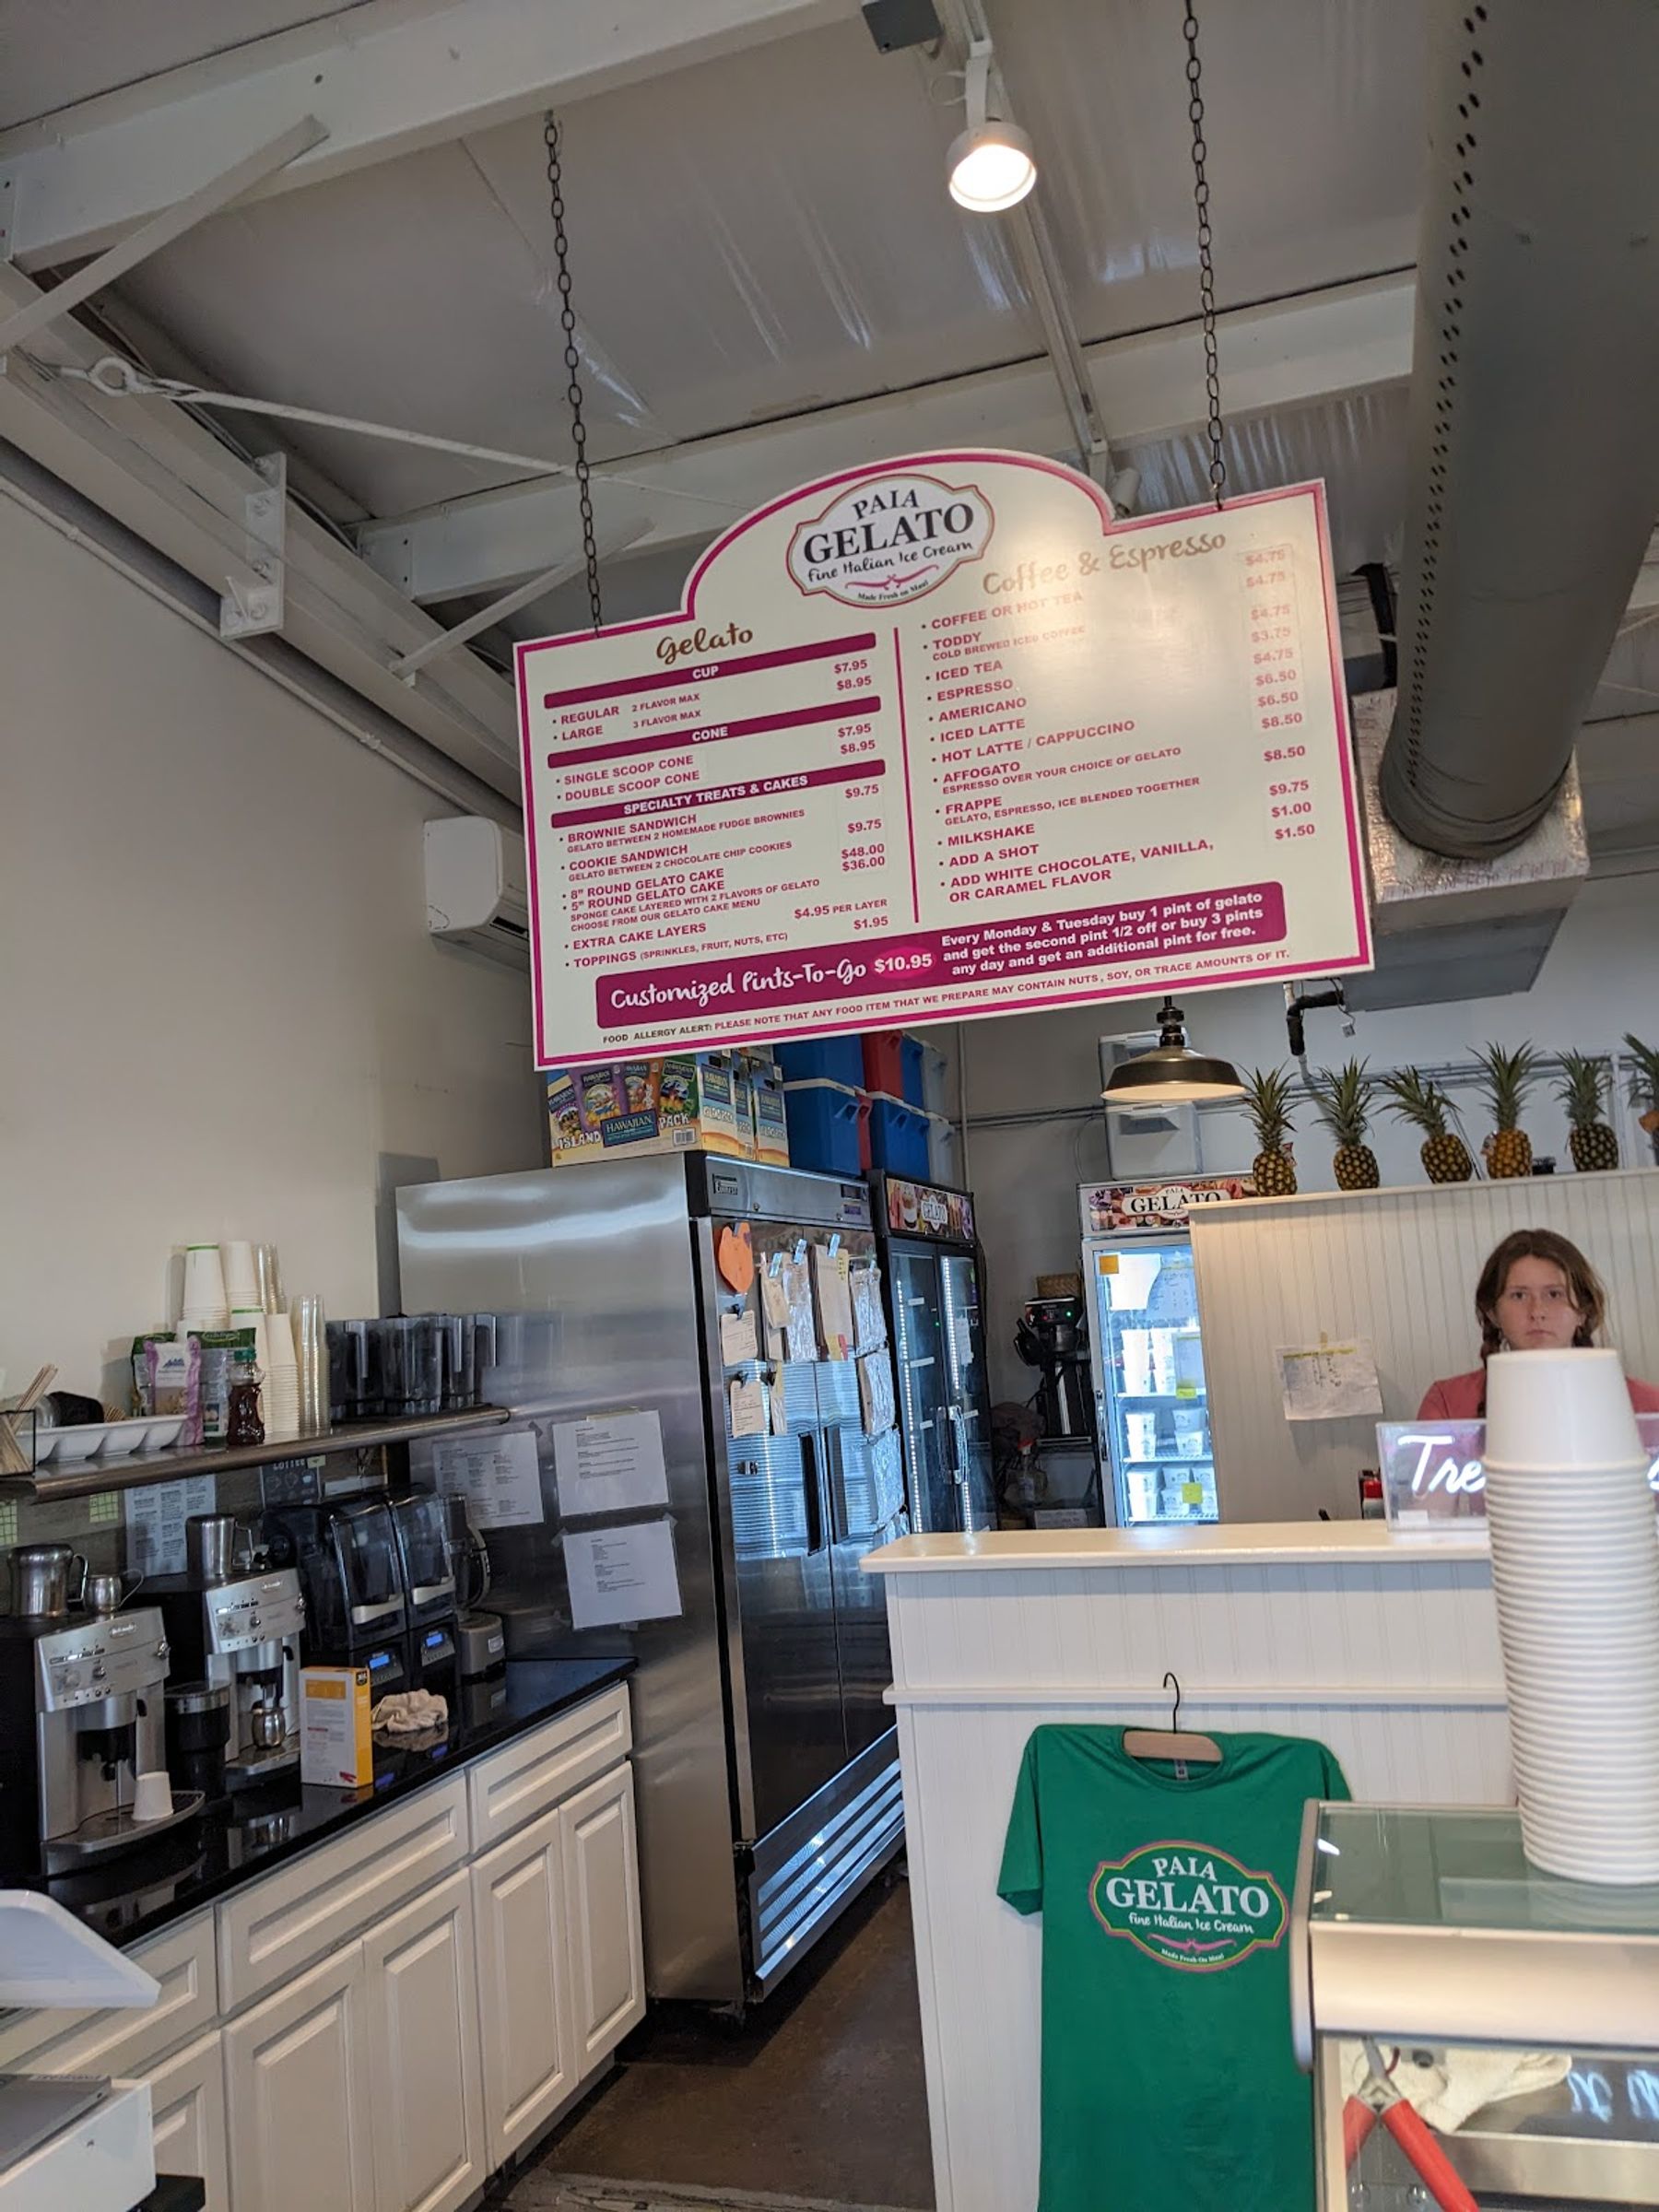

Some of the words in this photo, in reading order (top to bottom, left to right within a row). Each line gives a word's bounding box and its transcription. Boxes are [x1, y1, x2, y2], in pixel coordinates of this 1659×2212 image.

[852, 488, 921, 522] PAIA
[804, 503, 974, 565] GELATO
[842, 557, 895, 574] Italian
[900, 551, 919, 564] Ice
[923, 540, 973, 559] Cream
[982, 561, 1070, 595] Coffee
[1078, 552, 1100, 576] &
[1110, 533, 1227, 573] Espresso
[656, 622, 754, 665] Gelato
[931, 611, 986, 629] COFFEE
[933, 633, 981, 649] TODDY
[692, 666, 719, 678] CUP
[933, 649, 961, 661] COLD
[964, 641, 1010, 655] BREWED
[935, 666, 970, 681] ICED
[973, 661, 1003, 674] TEA
[561, 706, 619, 724] REGULAR
[640, 698, 677, 710] FLAVOR
[678, 694, 700, 703] MAX
[834, 660, 867, 674] $7.95
[562, 726, 603, 741] LARGE
[641, 714, 677, 727] FLAVOR
[679, 711, 700, 720] MAX
[837, 677, 872, 690] $8.95
[937, 680, 1013, 701] ESPRESSO
[939, 699, 1026, 722] AMERICANO
[940, 728, 974, 742] ICED
[979, 719, 1025, 735] LATTE
[1255, 670, 1297, 686] $6.50
[692, 727, 728, 741] CONE
[942, 748, 971, 762] HOT
[977, 740, 1023, 757] LATTE
[1028, 739, 1031, 747] /
[1036, 722, 1135, 746] CAPPUCCINO
[1258, 692, 1299, 707] $6.50
[944, 763, 1020, 782] AFFOGATO
[1262, 713, 1302, 729] $8.50
[564, 770, 609, 785] SINGLE
[612, 762, 654, 777] SCOOP
[658, 756, 693, 770] CONE
[838, 724, 871, 737] $7.95
[565, 785, 615, 801] DOUBLE
[618, 778, 661, 793] SCOOP
[665, 771, 700, 785] CONE
[841, 740, 876, 755] $8.95
[943, 779, 999, 794] ESPRESSO
[1002, 773, 1032, 784] OVER
[1035, 767, 1067, 778] YOUR
[1070, 759, 1112, 772] CHOICE
[1116, 756, 1131, 765] OF
[1135, 748, 1182, 761] GELATO
[624, 795, 692, 814] SPECIALTY
[696, 786, 746, 802] TREATS
[749, 784, 759, 794] &
[763, 776, 808, 792] CAKES
[945, 813, 991, 826] GELATO,
[994, 802, 1055, 818] ESPRESSO,
[1058, 797, 1077, 807] ICE
[1080, 789, 1133, 804] BLENDED
[1136, 778, 1200, 794] TOGETHER
[946, 797, 1002, 814] FRAPPE
[1264, 747, 1305, 761] $8.50
[568, 826, 626, 842] BROWNIE
[629, 816, 697, 833] SANDWICH
[845, 784, 879, 798] $9.75
[947, 824, 1035, 846] MILKSHAKE
[1269, 781, 1309, 796] $9.75
[949, 854, 979, 866] ADD
[984, 852, 994, 862] A
[999, 844, 1039, 859] SHOT
[1271, 803, 1312, 818] $1.00
[570, 856, 617, 871] COOKIE
[621, 845, 688, 863] SANDWICH
[847, 819, 882, 833] $9.75
[951, 875, 981, 888] ADD
[984, 866, 1032, 882] WHITE
[1038, 852, 1135, 874] CHOCOLATE,
[1140, 841, 1213, 858] VANILLA,
[1275, 825, 1315, 840] $1.50
[587, 883, 631, 897] ROUND
[635, 875, 685, 889] GELATO
[689, 869, 724, 882] CAKE
[841, 844, 885, 859] $48.00
[588, 895, 632, 909] ROUND
[636, 887, 686, 901] GELATO
[689, 881, 724, 894] CAKE
[842, 856, 885, 871] $36.00
[949, 891, 970, 902] OR
[975, 880, 1047, 899] CARAMEL
[1052, 870, 1112, 887] FLAVOR
[573, 936, 616, 949] EXTRA
[618, 931, 653, 943] CAKE
[657, 924, 706, 938] LAYERS
[794, 905, 830, 919] $4.95
[832, 904, 853, 913] PER
[854, 900, 888, 911] LAYER
[573, 952, 637, 967] TOPPINGS
[853, 916, 888, 930] $1.95
[942, 935, 980, 947] Every
[983, 926, 1037, 940] Monday
[1041, 922, 1053, 933] &
[1056, 915, 1115, 930] Tuesday
[1119, 911, 1146, 922] buy
[1150, 907, 1158, 917] 1
[1163, 902, 1192, 918] pint
[1195, 900, 1211, 911] of
[1215, 894, 1263, 911] gelato
[943, 948, 969, 961] and
[972, 946, 994, 959] get
[998, 943, 1021, 954] the
[1025, 934, 1077, 950] second
[1080, 930, 1108, 945] pint
[1112, 925, 1133, 937] 1/2
[1136, 923, 1157, 935] off
[1160, 922, 1177, 931] or
[1180, 917, 1207, 929] buy
[1211, 914, 1221, 924] 3
[1225, 910, 1264, 924] pints
[952, 964, 976, 975] any
[980, 960, 1005, 971] day
[1008, 955, 1034, 968] and
[1038, 951, 1062, 965] get
[1065, 950, 1083, 959] an
[1087, 939, 1159, 957] additional
[1163, 935, 1193, 949] pint
[1195, 932, 1218, 942] for
[1220, 927, 1255, 938] free.
[611, 972, 735, 1009] Customized
[874, 954, 933, 975] $10.95
[557, 1131, 601, 1151] ISLAND
[606, 1115, 653, 1134] HAWAIIAN
[658, 1112, 690, 1130] PACK
[1397, 1435, 1488, 1500] Tre
[1152, 1855, 1218, 1882] PAIA
[1106, 1877, 1270, 1918] GELATO
[1154, 1913, 1194, 1932] Italian
[1194, 1918, 1212, 1932] Ice
[1213, 1919, 1254, 1935] Cream
